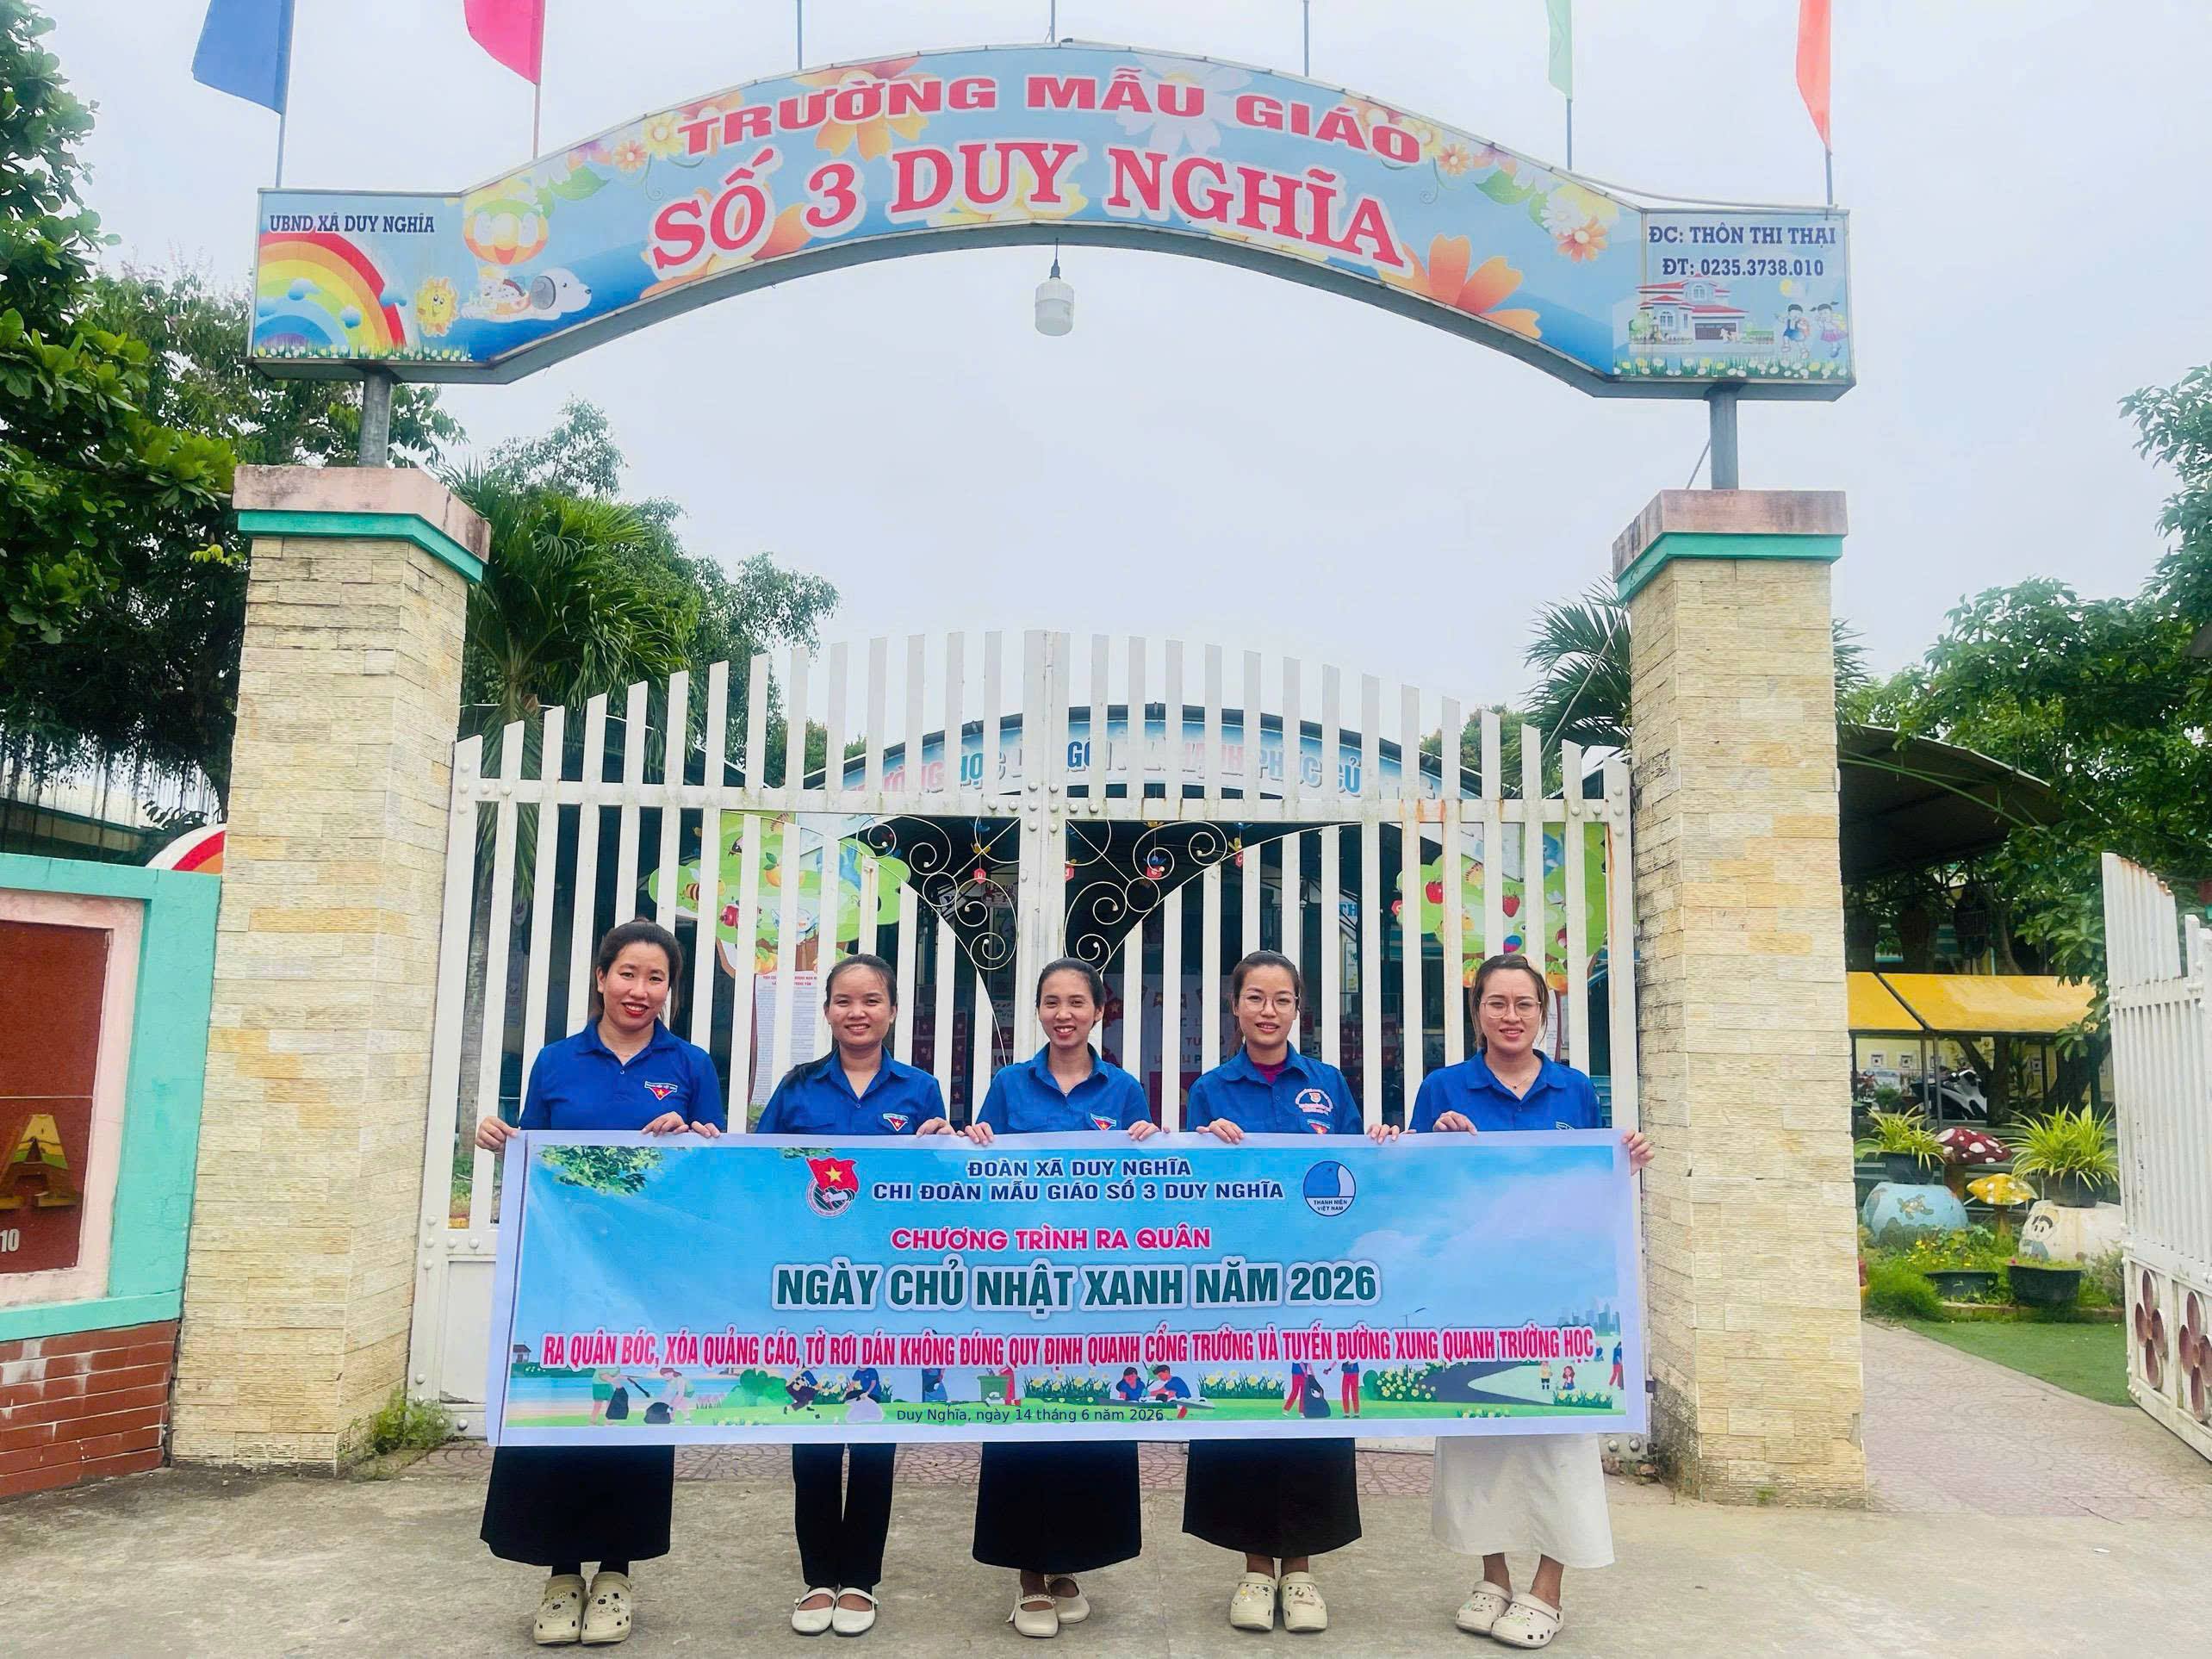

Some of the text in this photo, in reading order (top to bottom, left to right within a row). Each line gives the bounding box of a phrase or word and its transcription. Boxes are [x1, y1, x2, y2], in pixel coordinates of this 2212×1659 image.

[677, 68, 1420, 164] TRƯỜNG MẪU GIÁO
[652, 142, 1404, 270] SỐ 3 DUY NGHĨA
[270, 212, 435, 233] UBND XÃ DUY NGHĨA
[1649, 221, 1836, 249] ĐC: THÔN THI THẠI
[1662, 258, 1824, 276] ĐT: 0235.3738.010
[967, 1158, 1191, 1177] ĐOÀN XÃ DUY NGHĨA
[873, 1184, 911, 1200] CHI
[919, 1183, 981, 1200] ĐOÀN
[991, 1180, 1038, 1200] MẪU
[1047, 1182, 1098, 1200] GIÁO
[1106, 1179, 1135, 1199] SỐ
[1143, 1183, 1156, 1199] 3
[1165, 1183, 1208, 1199] DUY
[1216, 1181, 1283, 1199] NGHĨA
[892, 1224, 1211, 1250] CHƯƠNG TRÌNH RA QUÂN
[777, 1258, 1376, 1314] NGÀY CHỦ NHẬT XANH NĂM 2026
[544, 1323, 1594, 1371] RA QUÂN BÓC, XÓA QUẢNG CÁO, TỜ RƠI DÁN KHÔNG ĐÚNG QUY ĐỊNH QUANH CỔNG TRƯỜNG VÀ TUYẾN ĐƯỜNG XUNG QUANH TRƯỜNG HỌC
[897, 1407, 1164, 1422] Duy Nghĩa, ngày 14 tháng 6 năm 2026
